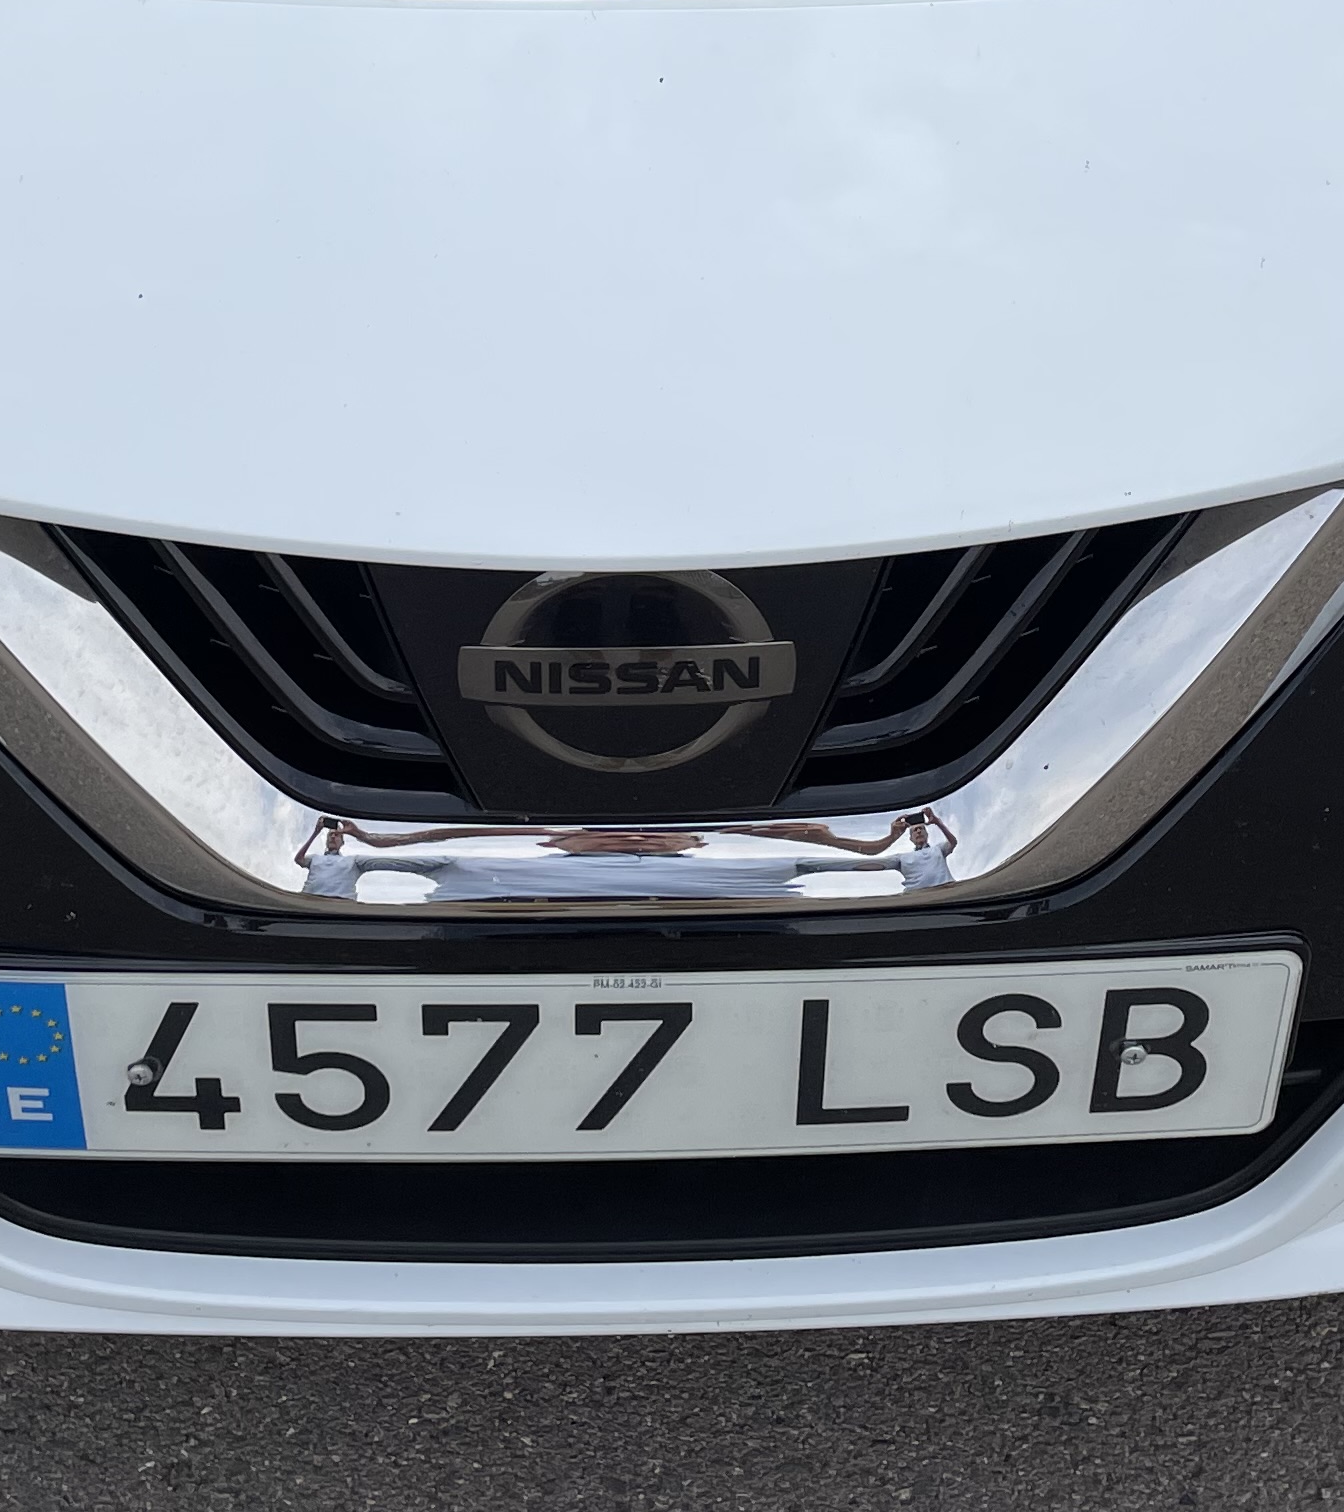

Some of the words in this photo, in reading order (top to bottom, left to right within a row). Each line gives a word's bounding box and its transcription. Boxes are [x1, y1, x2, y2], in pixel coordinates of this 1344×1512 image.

[494, 657, 760, 695] NISSAN
[122, 1002, 695, 1135] 4577
[798, 989, 1210, 1125] LSB
[7, 1086, 54, 1121] E
